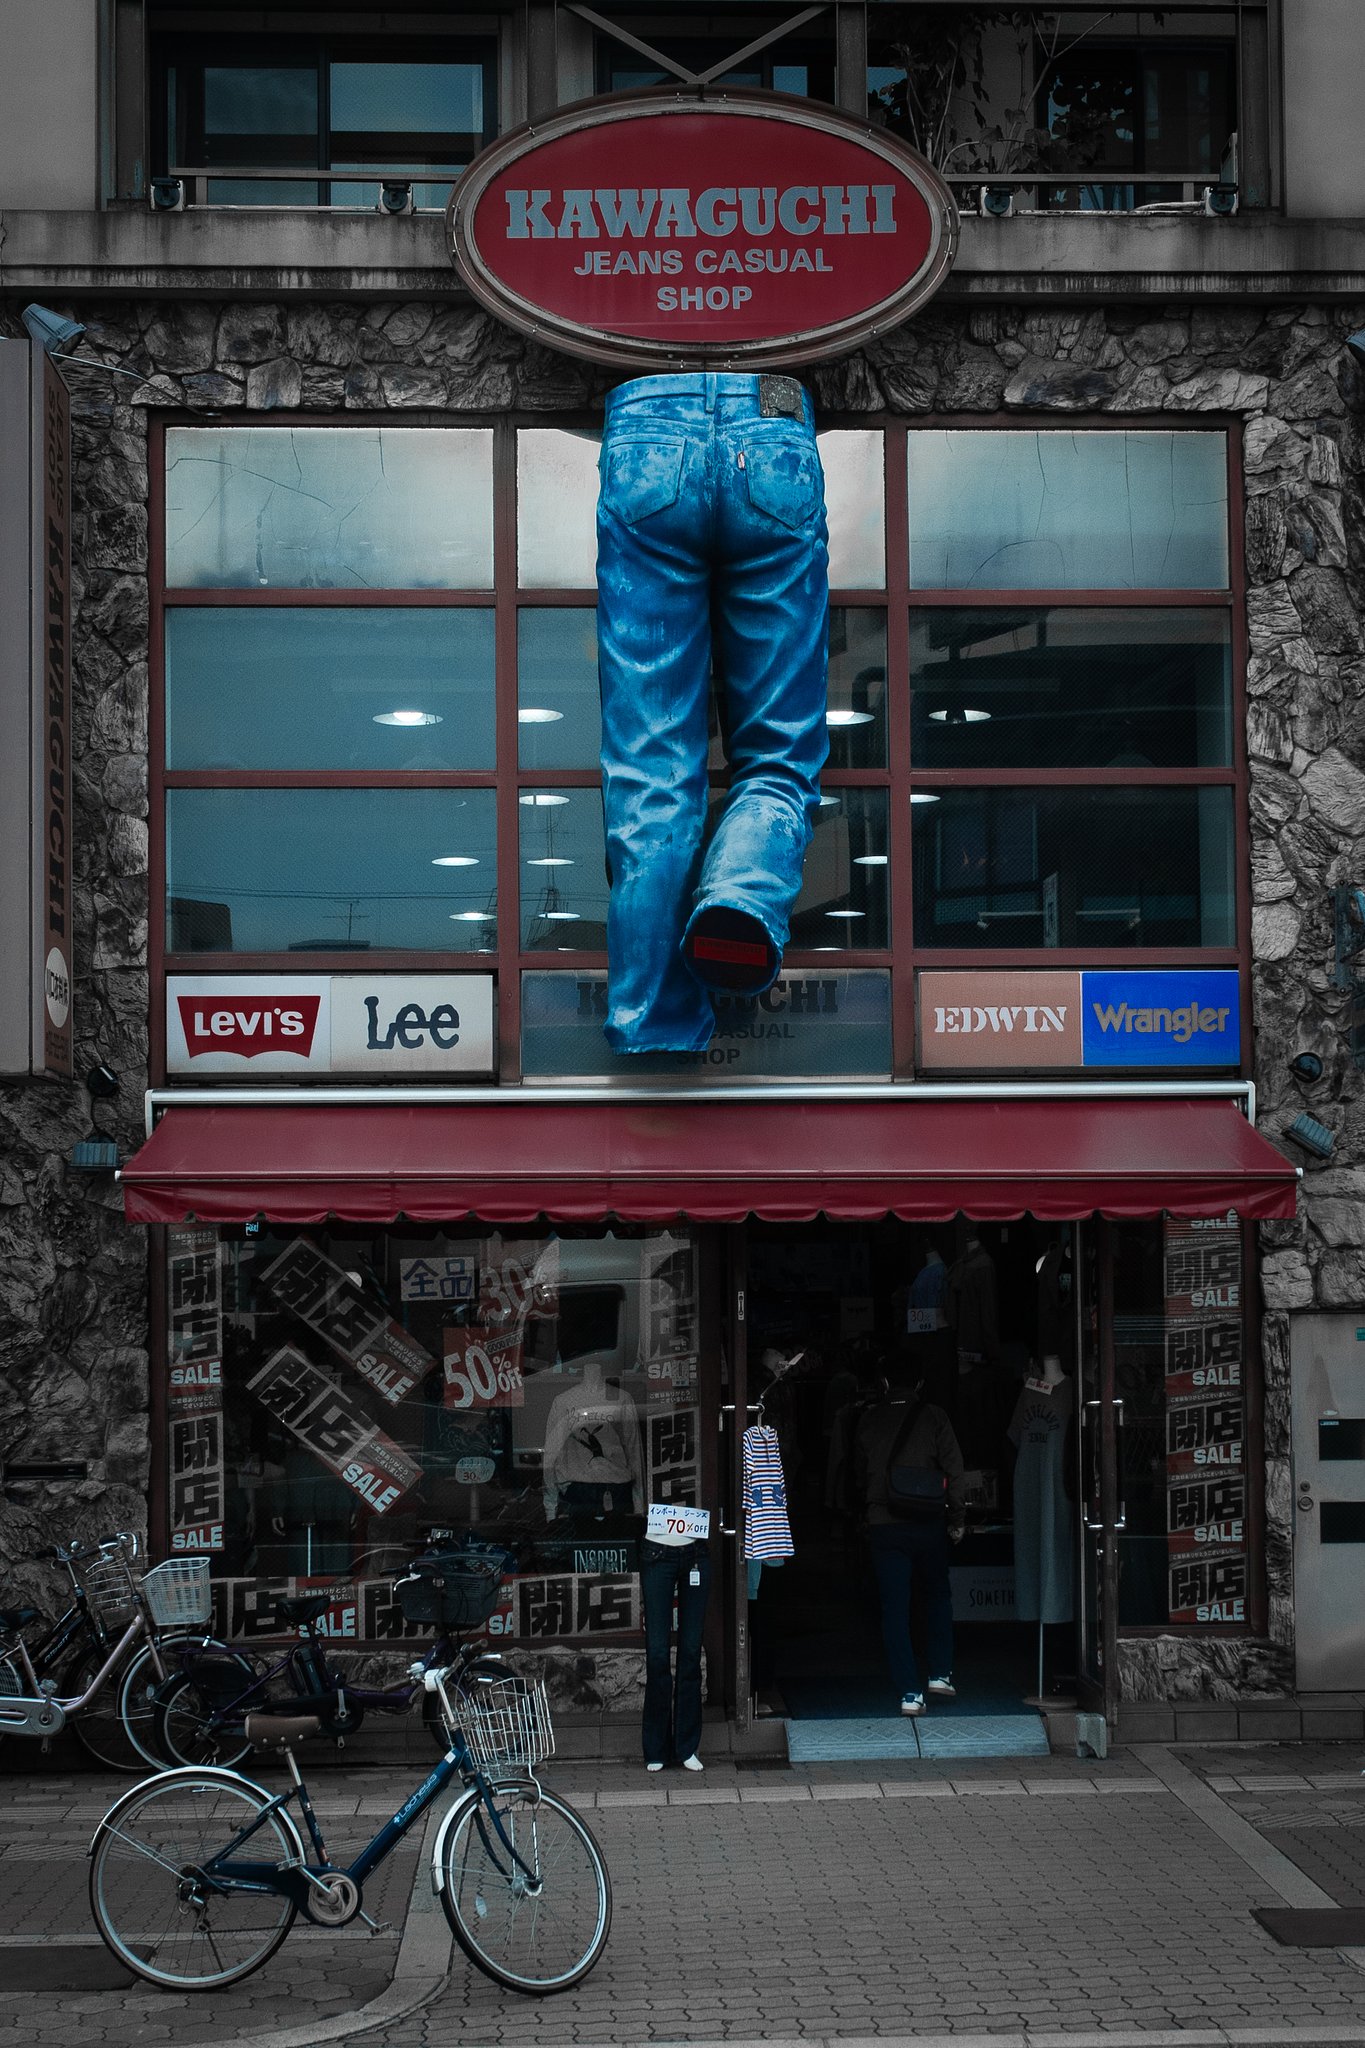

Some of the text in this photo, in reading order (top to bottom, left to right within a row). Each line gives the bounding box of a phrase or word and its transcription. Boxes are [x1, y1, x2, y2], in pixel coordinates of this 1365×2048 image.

[505, 185, 897, 239] KAWAGUCHI
[574, 248, 833, 275] JEANS CASUAL
[656, 286, 753, 312] SHOP
[48, 386, 56, 501] SHOP
[56, 391, 64, 519] JEANS
[48, 515, 65, 938] KAWAGUCHI
[364, 995, 460, 1050] Lee
[934, 1006, 1068, 1033] EDWIN
[1092, 1001, 1230, 1043] Wrangler
[266, 1241, 387, 1355] 閉店
[403, 1259, 472, 1298] 全品
[1191, 1286, 1239, 1307] SALE
[173, 1253, 217, 1363] 閉店
[171, 1361, 221, 1385] SALE
[1168, 1323, 1240, 1373] 閉店
[356, 1353, 414, 1403] SALE
[498, 1367, 523, 1392] OFF
[1192, 1364, 1240, 1385] SALE
[252, 1350, 372, 1464] 閉店
[1169, 1401, 1242, 1451] 閉店
[174, 1416, 219, 1529] 閉店
[1193, 1442, 1242, 1464] SALE
[342, 1463, 401, 1513] SALE
[1170, 1480, 1243, 1530] 閉店
[172, 1525, 223, 1549] SALE
[1194, 1520, 1243, 1542] SALE
[519, 1577, 632, 1638] 閉店
[1172, 1556, 1245, 1609] 閉店
[1196, 1599, 1245, 1621] SALE
